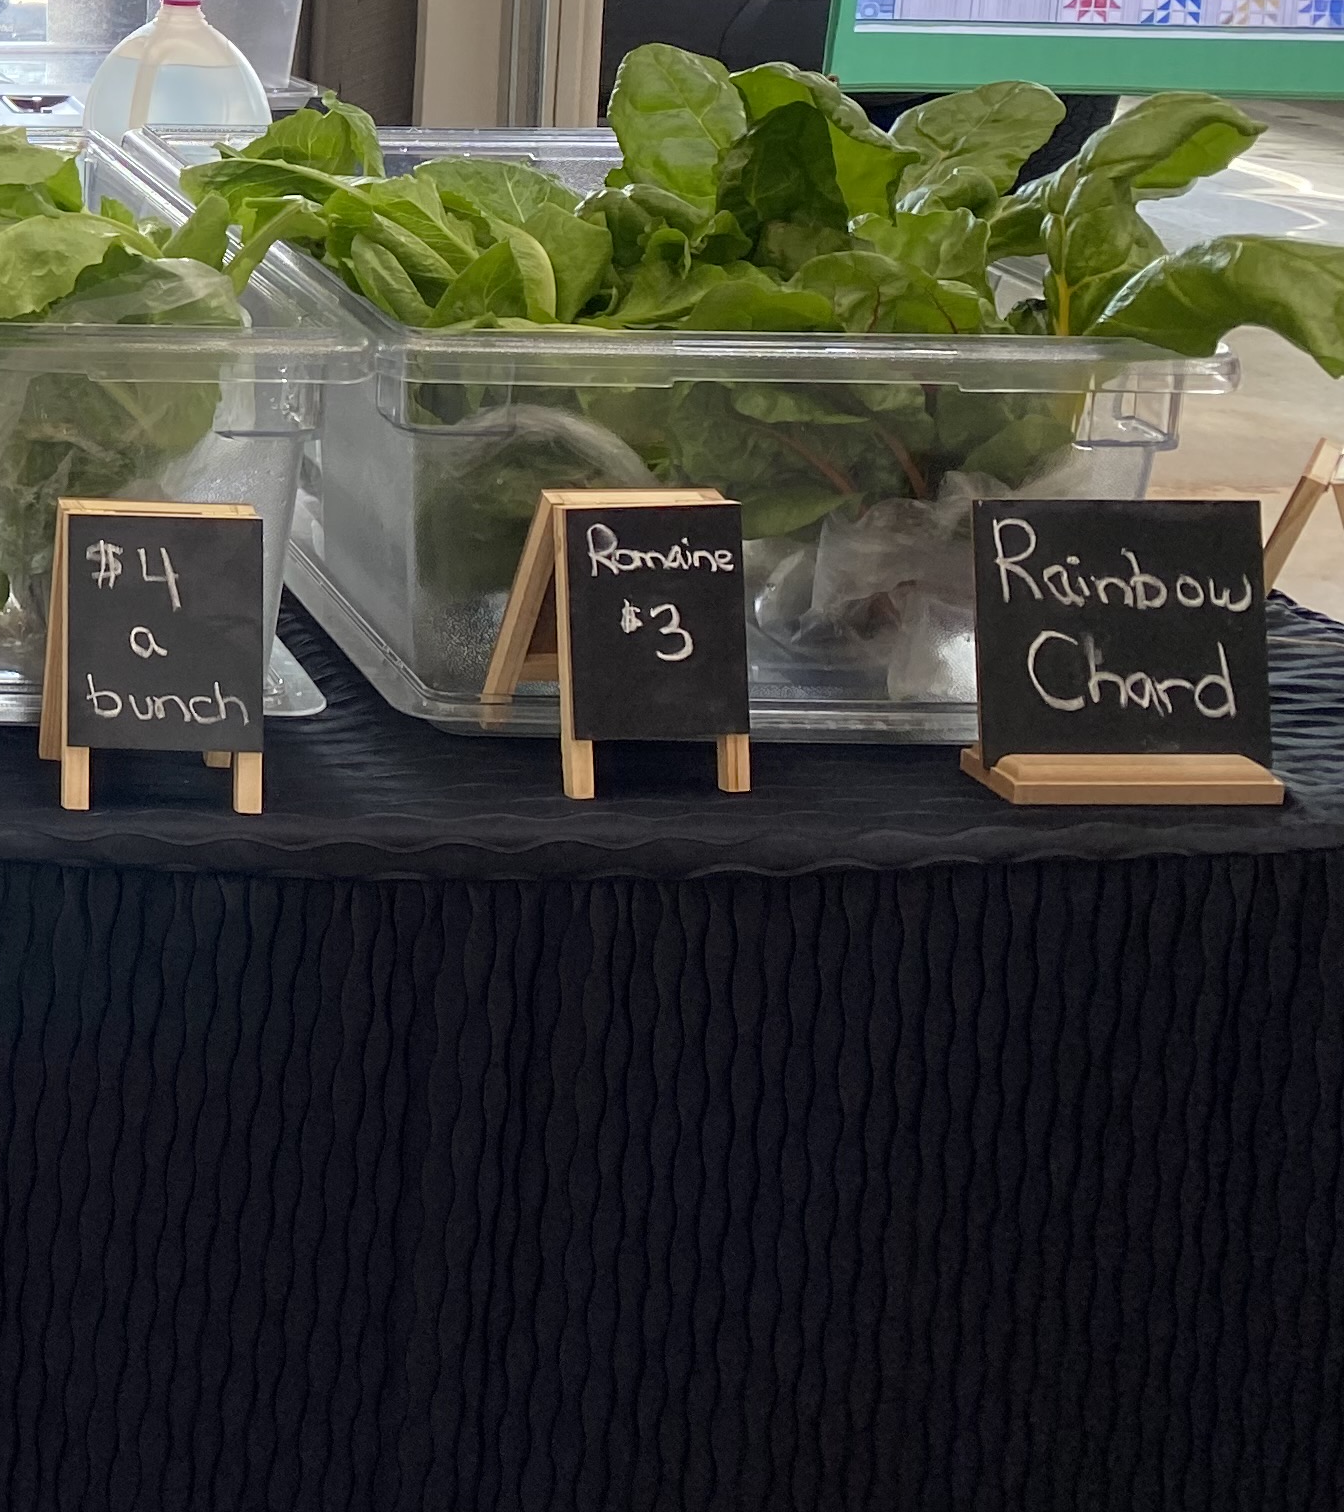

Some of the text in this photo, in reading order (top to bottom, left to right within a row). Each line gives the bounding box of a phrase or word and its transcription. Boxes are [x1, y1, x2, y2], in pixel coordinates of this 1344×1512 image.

[85, 539, 181, 612] $4
[586, 523, 736, 578] Romaine
[992, 517, 1255, 612] Rainbow
[129, 625, 169, 658] a
[620, 598, 695, 662] $3
[86, 673, 251, 727] bunch
[1027, 629, 1237, 719] Chard
